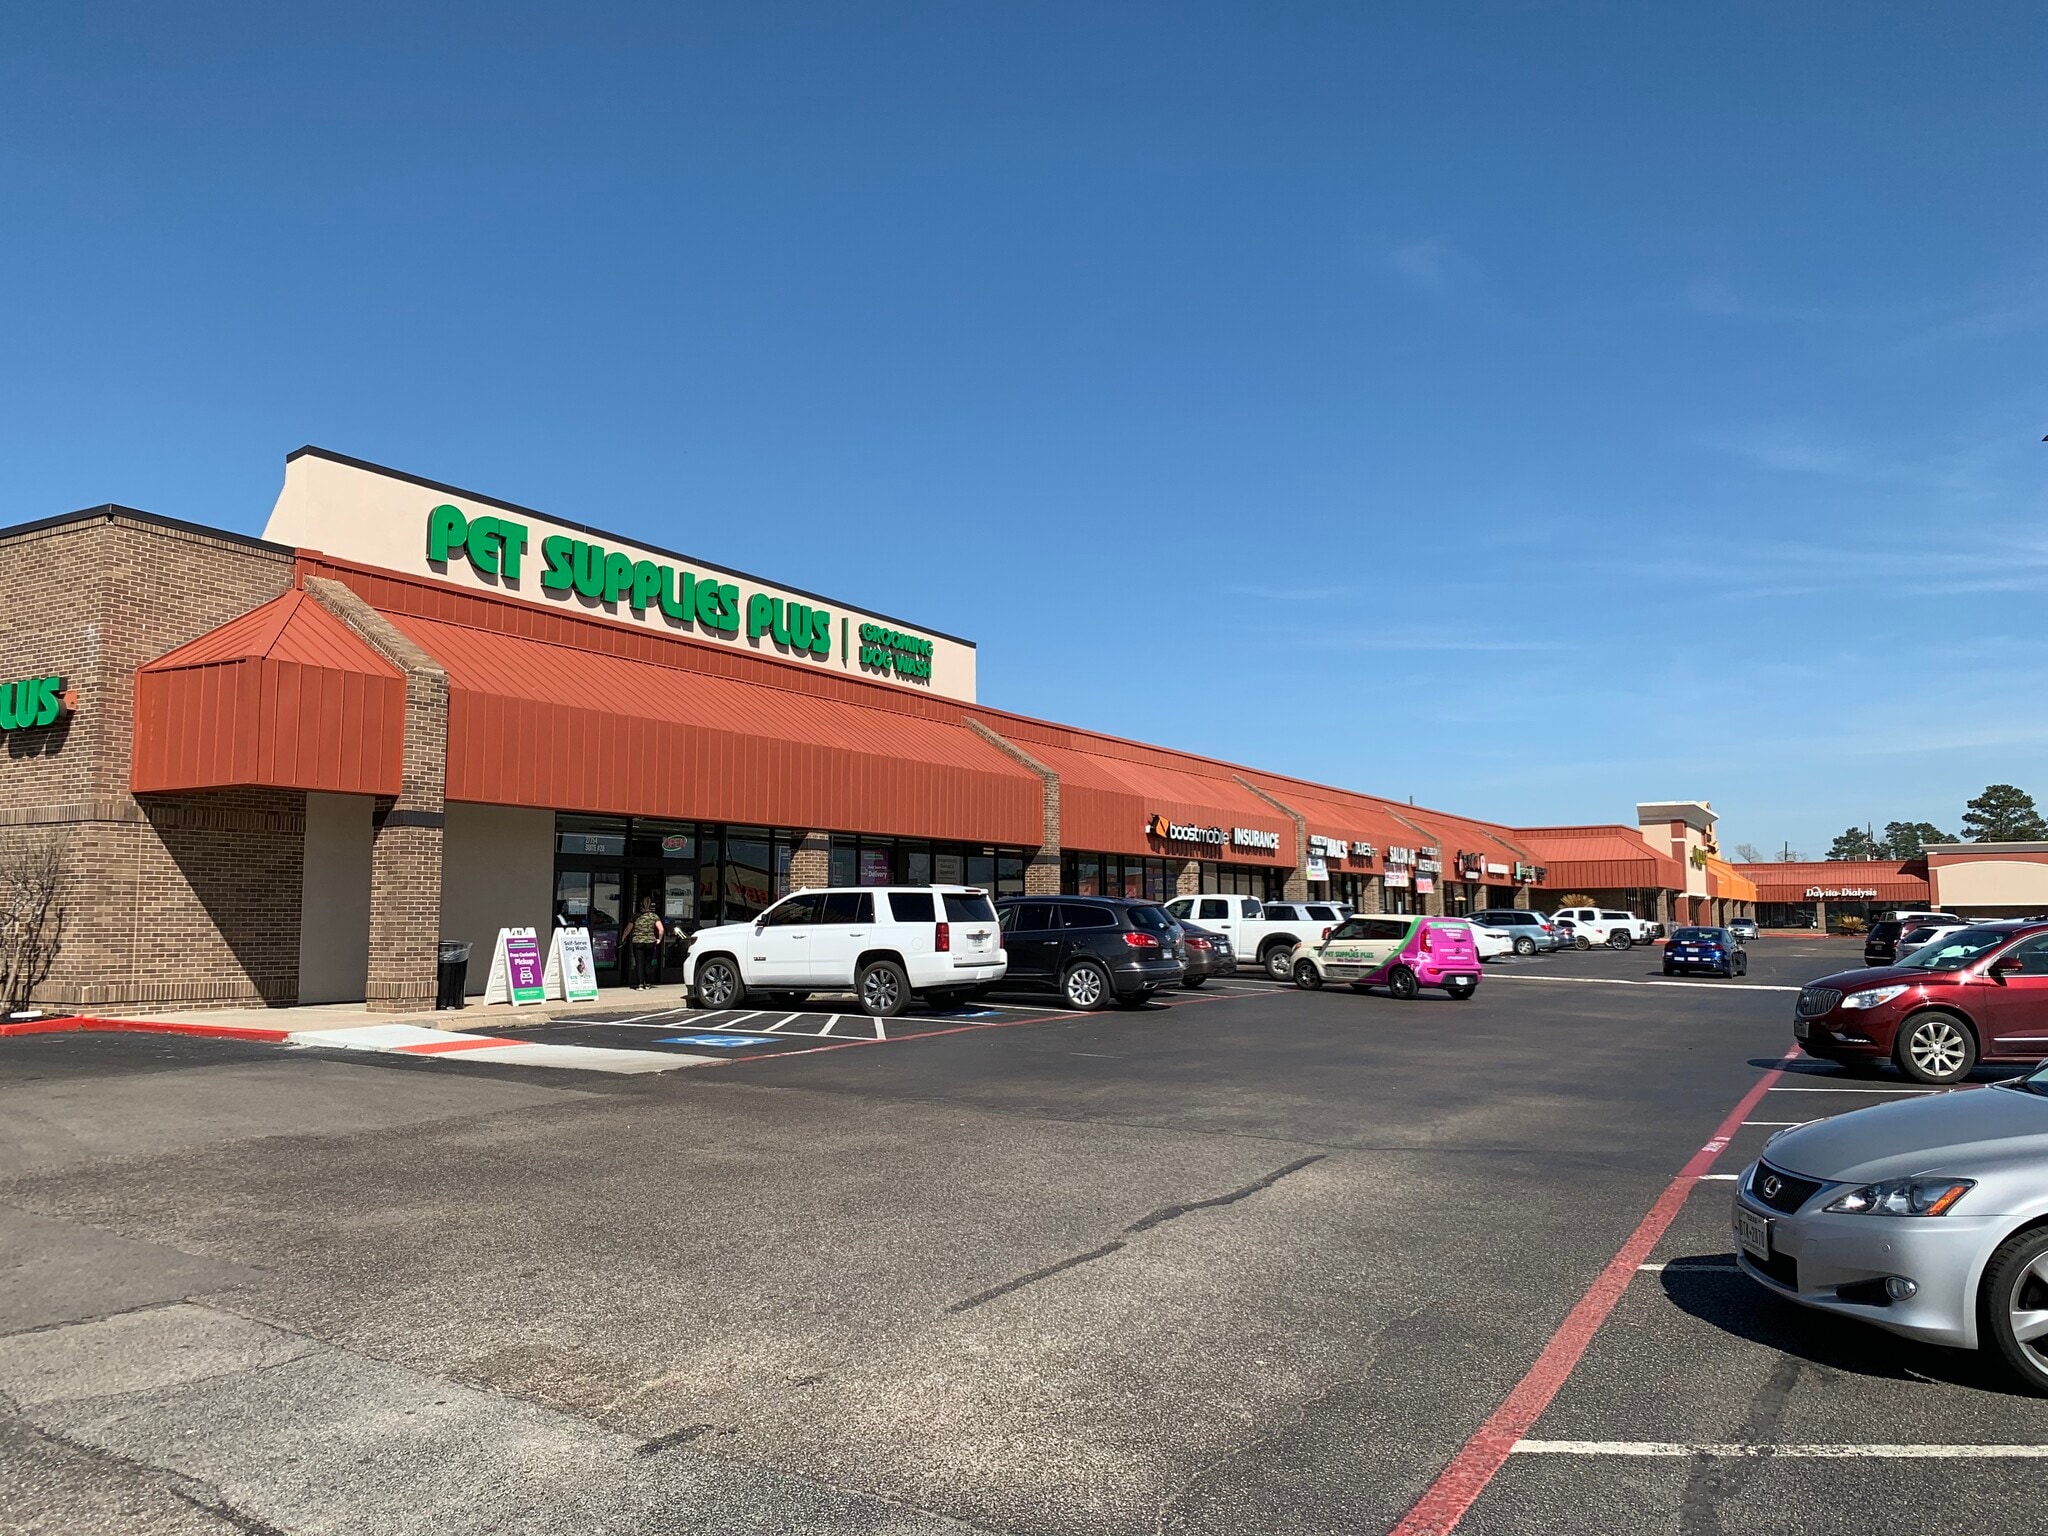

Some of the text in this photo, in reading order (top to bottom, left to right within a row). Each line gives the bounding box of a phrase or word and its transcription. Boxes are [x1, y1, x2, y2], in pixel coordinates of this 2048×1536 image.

[426, 504, 831, 654] PET SUPPLIES PLUS
[861, 623, 933, 657] GROOMING
[861, 646, 931, 679] DOG WASH
[0, 676, 59, 730] LUS
[663, 837, 687, 848] OPEN
[1234, 827, 1279, 849] INSURANCE
[868, 870, 887, 879] Delivery
[514, 958, 534, 966] Pickup
